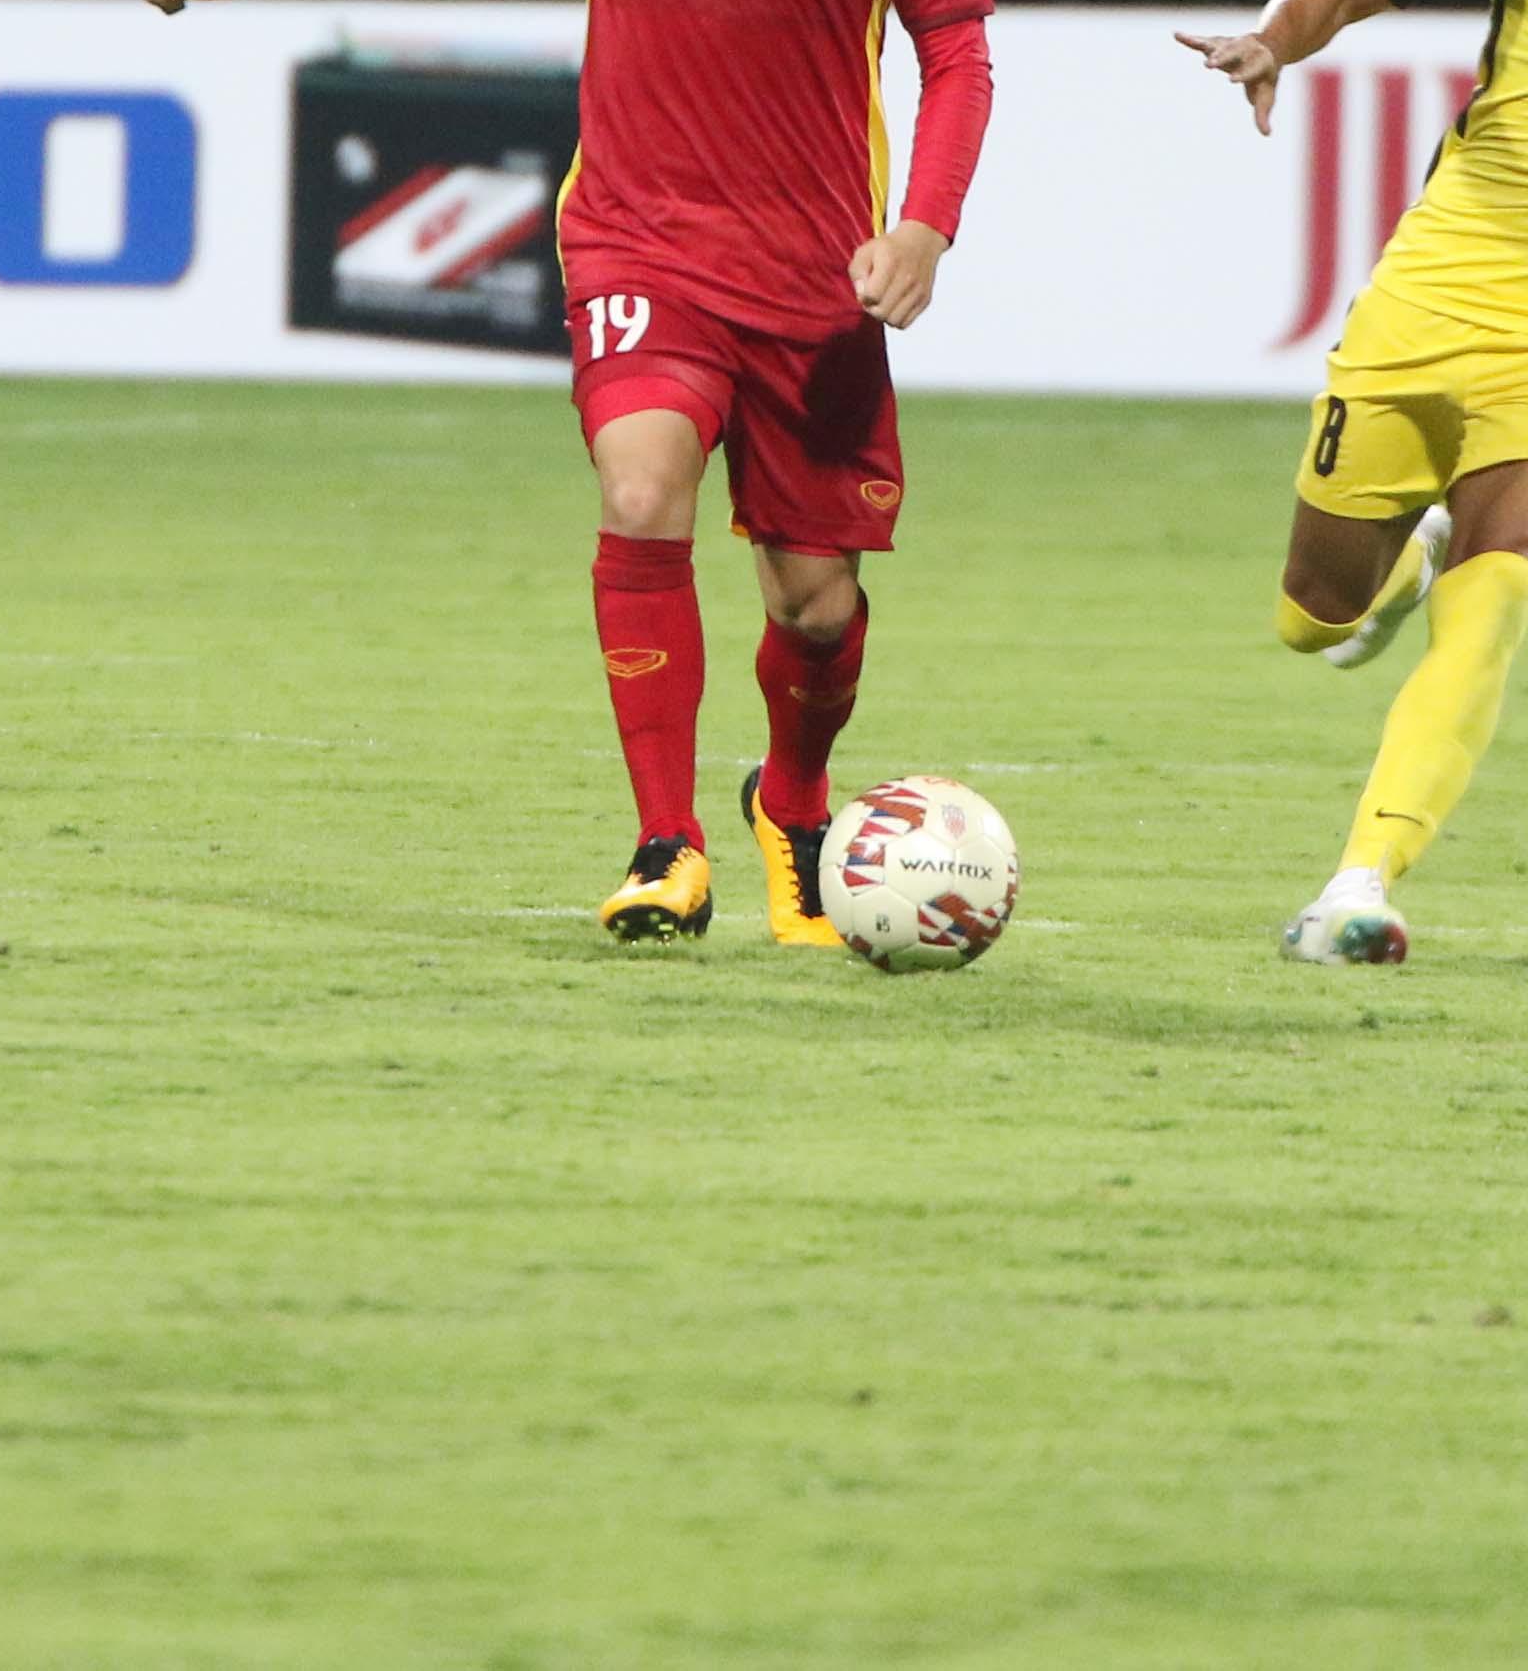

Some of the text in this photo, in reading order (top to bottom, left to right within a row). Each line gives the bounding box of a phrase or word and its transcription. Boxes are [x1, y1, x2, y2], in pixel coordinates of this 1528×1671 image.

[586, 294, 651, 359] 19
[1314, 396, 1347, 476] 8
[899, 858, 994, 881] WARRIX
